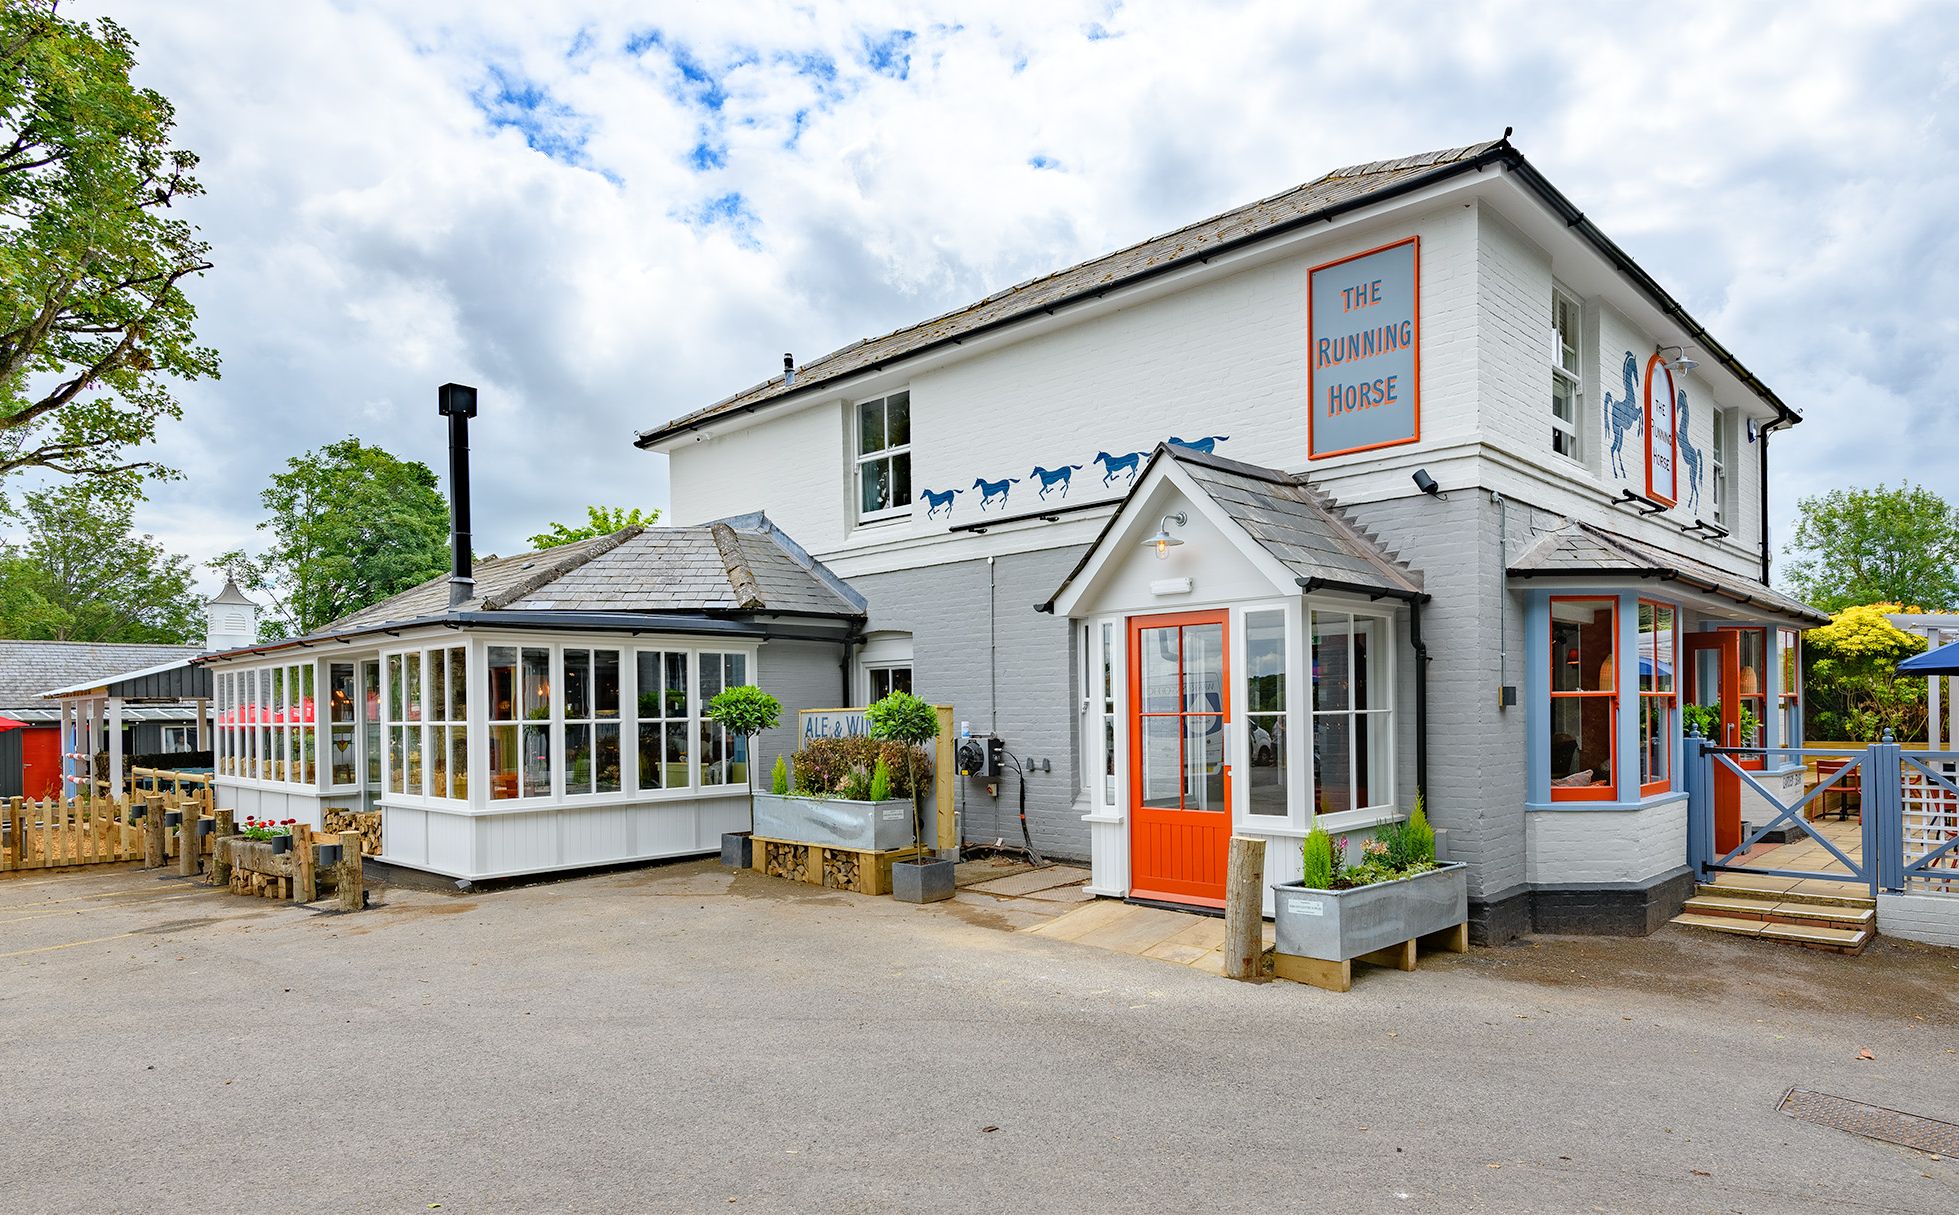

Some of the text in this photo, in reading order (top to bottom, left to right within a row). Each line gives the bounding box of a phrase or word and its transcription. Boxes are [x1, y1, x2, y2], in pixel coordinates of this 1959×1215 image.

[1340, 279, 1382, 313] THE
[1316, 319, 1412, 370] RUNNING
[1327, 375, 1398, 418] HORSE
[1655, 399, 1666, 417] THE
[1653, 446, 1670, 472] HORSE
[805, 715, 876, 738] ALE & WIN
